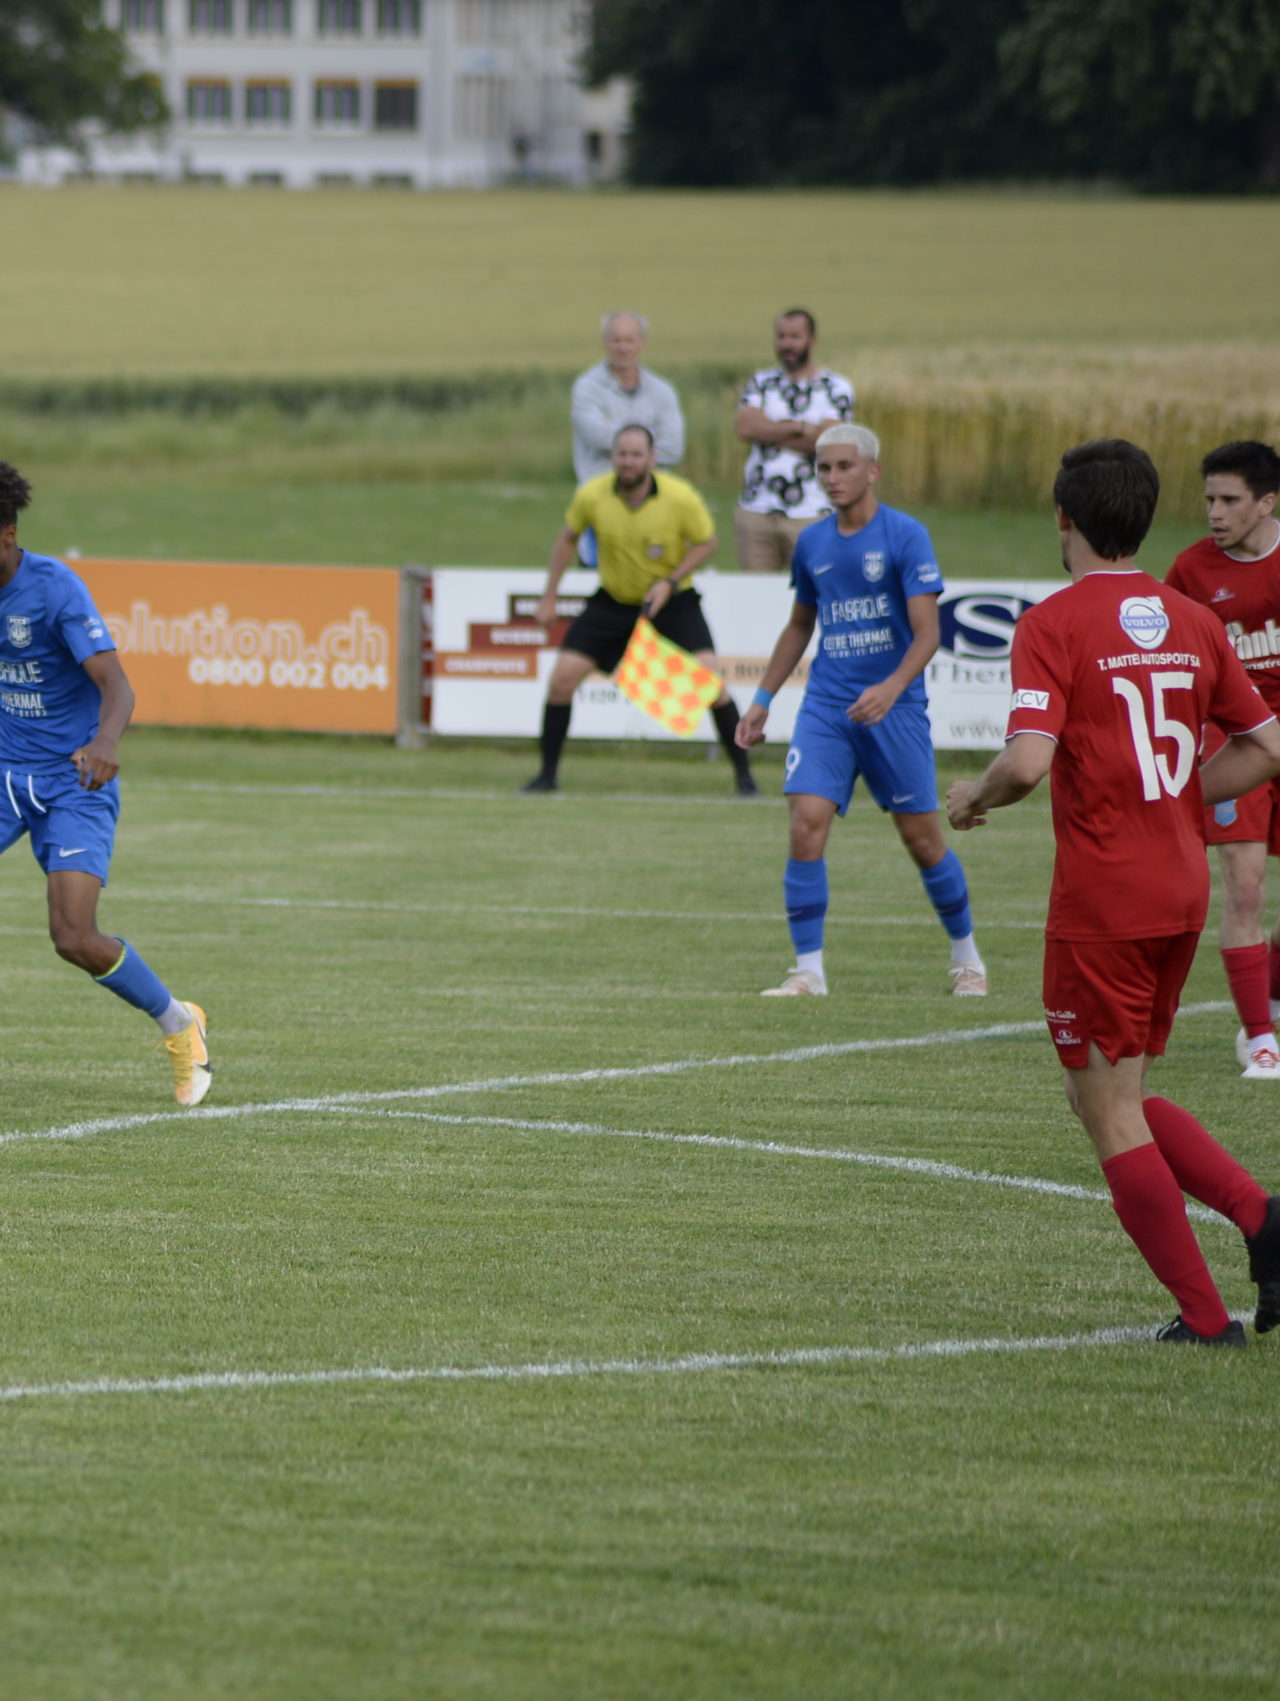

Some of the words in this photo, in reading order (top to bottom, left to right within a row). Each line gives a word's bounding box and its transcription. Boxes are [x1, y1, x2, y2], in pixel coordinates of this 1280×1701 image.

[1123, 617, 1165, 628] VOLVO
[188, 657, 265, 687] 0800
[271, 659, 327, 689] 002
[331, 661, 390, 692] 004
[1112, 671, 1195, 801] 15
[785, 747, 801, 781] 9
